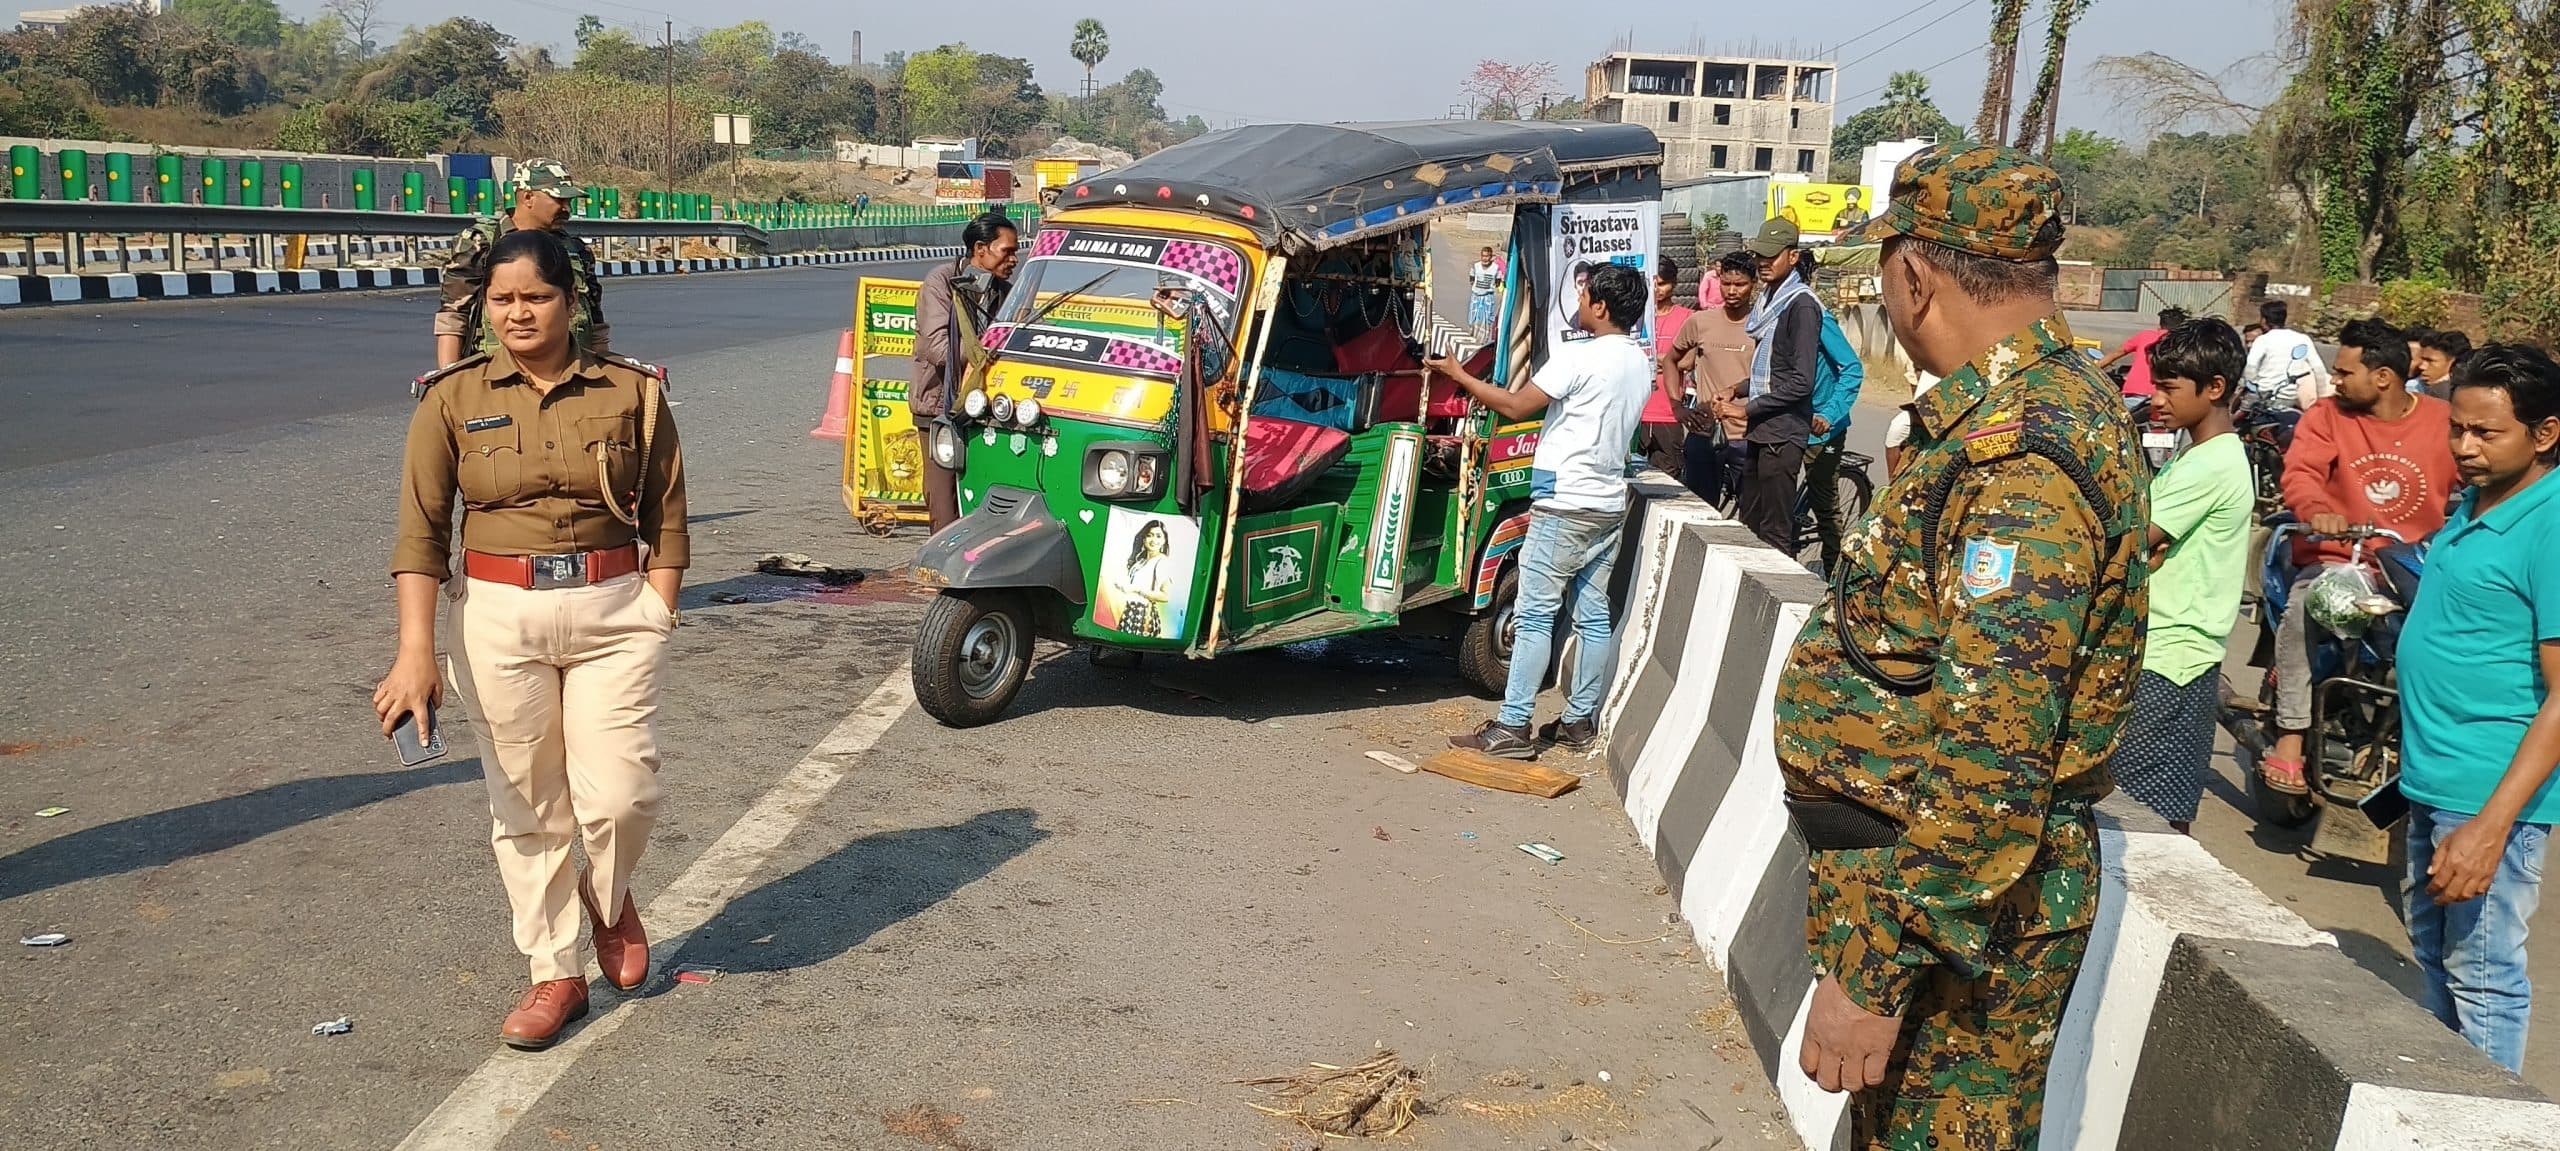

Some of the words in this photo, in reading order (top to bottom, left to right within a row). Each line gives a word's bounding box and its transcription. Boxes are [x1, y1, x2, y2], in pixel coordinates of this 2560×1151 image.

[1560, 215, 1639, 235] Srivastava
[1119, 244, 1153, 258] TARA
[1579, 236, 1632, 254] Classes
[1029, 334, 1089, 352] 2023
[875, 406, 889, 417] 72
[1507, 433, 1538, 457] Jai
